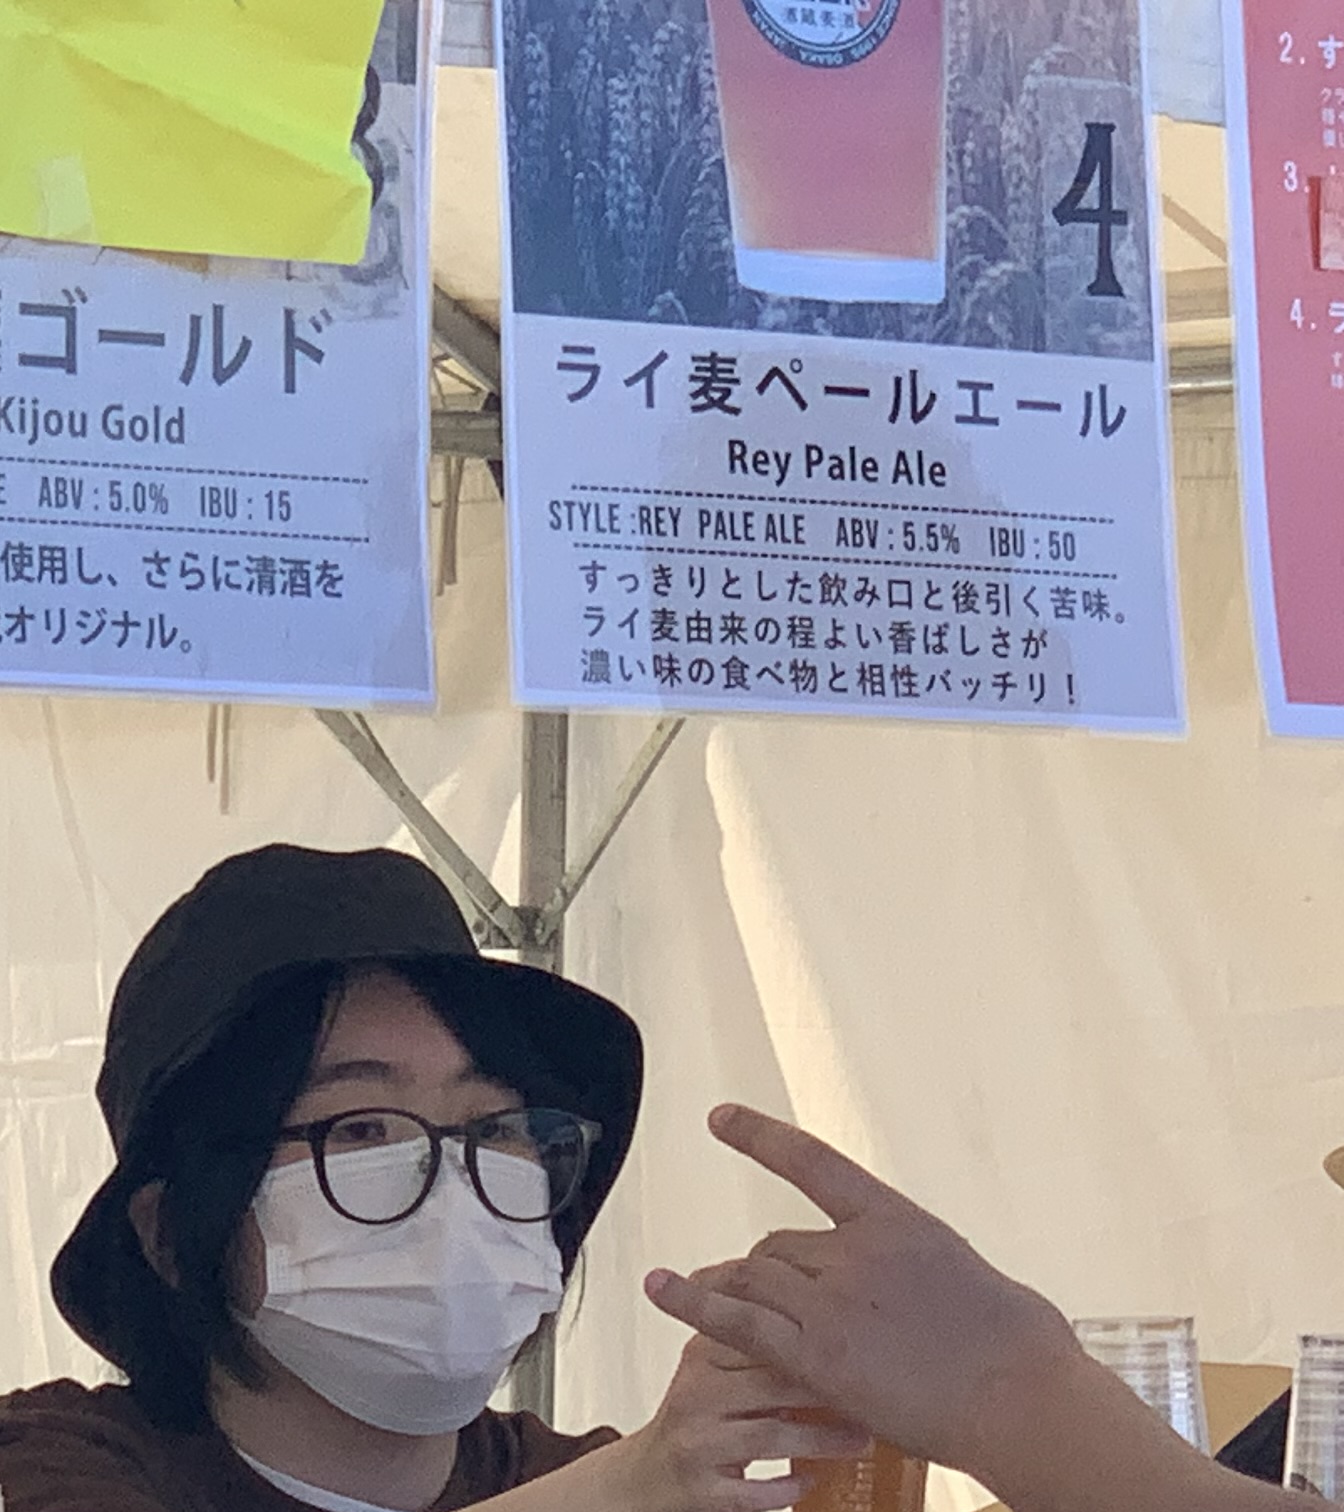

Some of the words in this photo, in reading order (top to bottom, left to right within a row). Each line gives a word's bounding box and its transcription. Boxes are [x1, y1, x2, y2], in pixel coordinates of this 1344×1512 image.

[1051, 121, 1128, 298] 4
[555, 343, 1127, 439] ライ麦ペールエール
[102, 405, 186, 445] Gold
[728, 440, 790, 486] Rey
[806, 444, 879, 484] Pale
[891, 450, 947, 488] Ale
[38, 478, 85, 511] ABV
[109, 481, 168, 515] 5.0%
[200, 487, 239, 519] IBU
[264, 490, 292, 522] 15
[699, 509, 755, 542] PALE
[766, 513, 806, 545] ALE
[836, 516, 879, 549] ABV
[902, 519, 960, 554] 5.5%
[989, 527, 1025, 558] IBU
[1048, 530, 1076, 561] 50
[579, 560, 1127, 625] すっきりとした飲み口と後引く苦味。
[581, 606, 1048, 659] ライ麦由来の程よい香ばしさが
